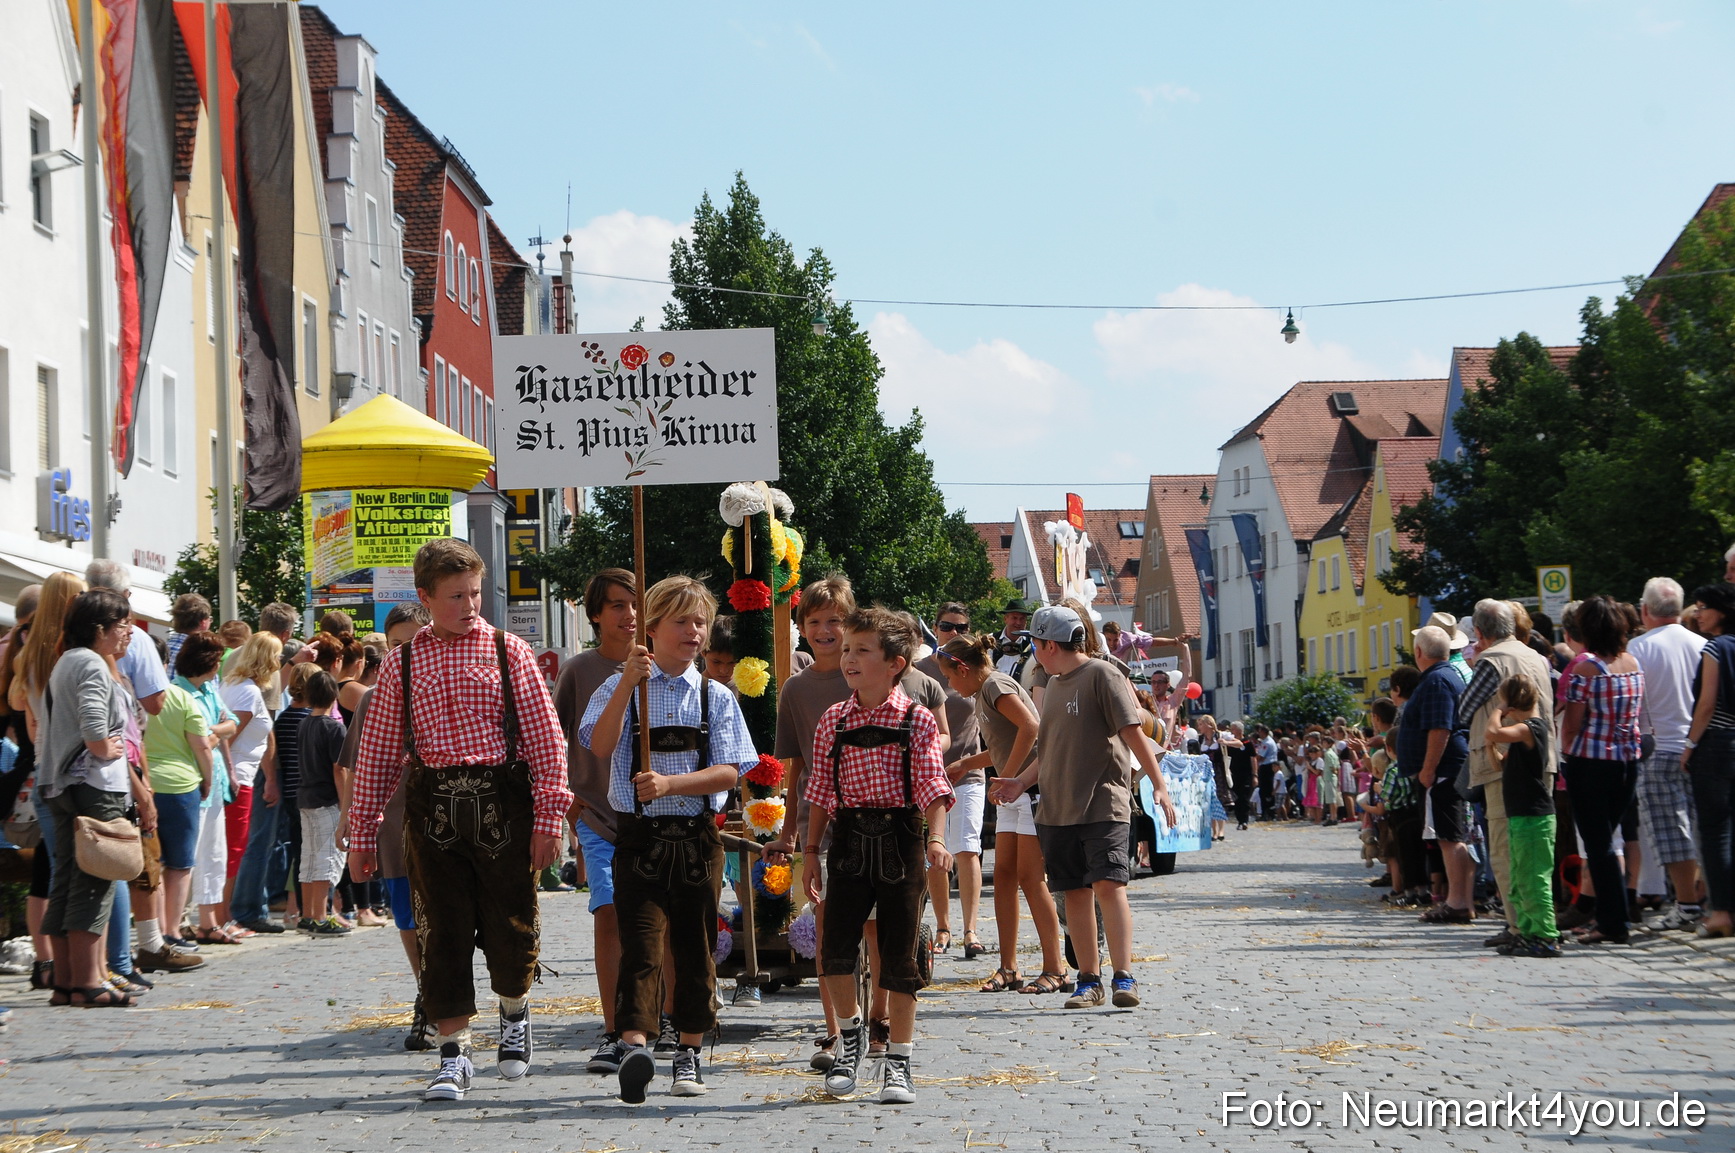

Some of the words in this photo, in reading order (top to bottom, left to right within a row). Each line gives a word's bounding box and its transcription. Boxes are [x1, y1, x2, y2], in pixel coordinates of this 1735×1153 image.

[515, 360, 757, 413] Hasenheider
[516, 419, 565, 451] St.
[577, 417, 649, 457] Pius
[661, 415, 757, 447] Kirwa
[356, 493, 385, 504] New
[389, 492, 426, 504] Berlin
[429, 492, 449, 504] Club
[356, 507, 450, 520] Volksfest
[512, 616, 536, 624] Stern
